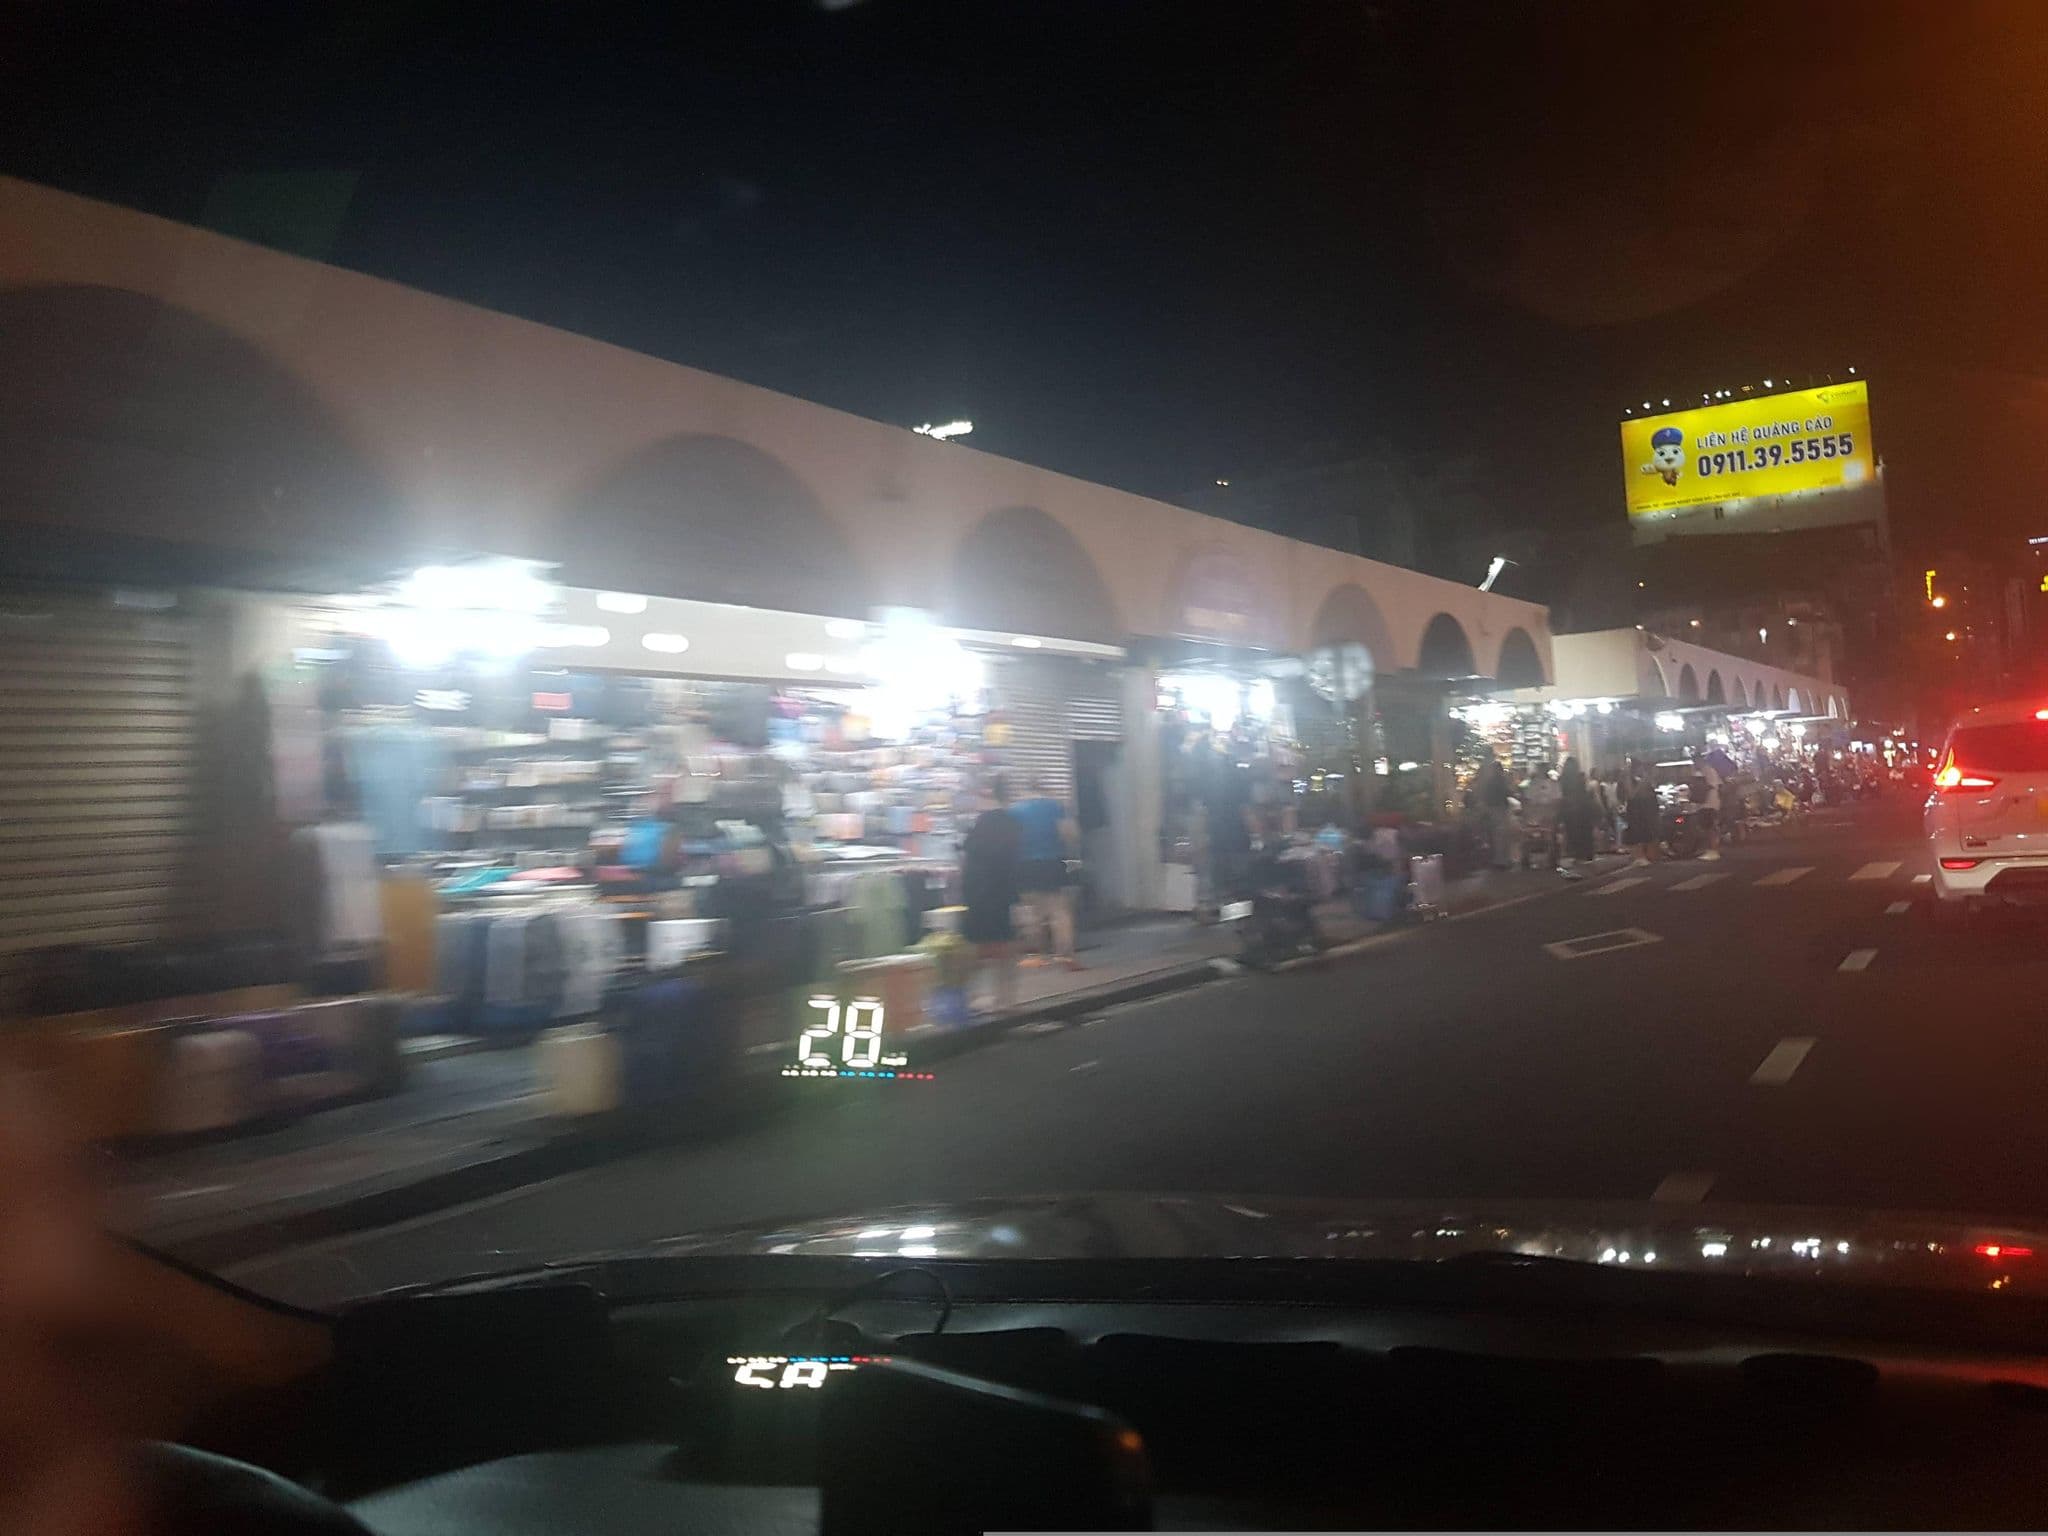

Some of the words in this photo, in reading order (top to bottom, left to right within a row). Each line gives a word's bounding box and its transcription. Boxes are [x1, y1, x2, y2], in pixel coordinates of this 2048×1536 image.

[1697, 431, 1726, 448] LIÊN
[1731, 426, 1749, 446] HỆ
[1698, 432, 1853, 477] 0911.39.5555
[798, 998, 884, 1068] 28
